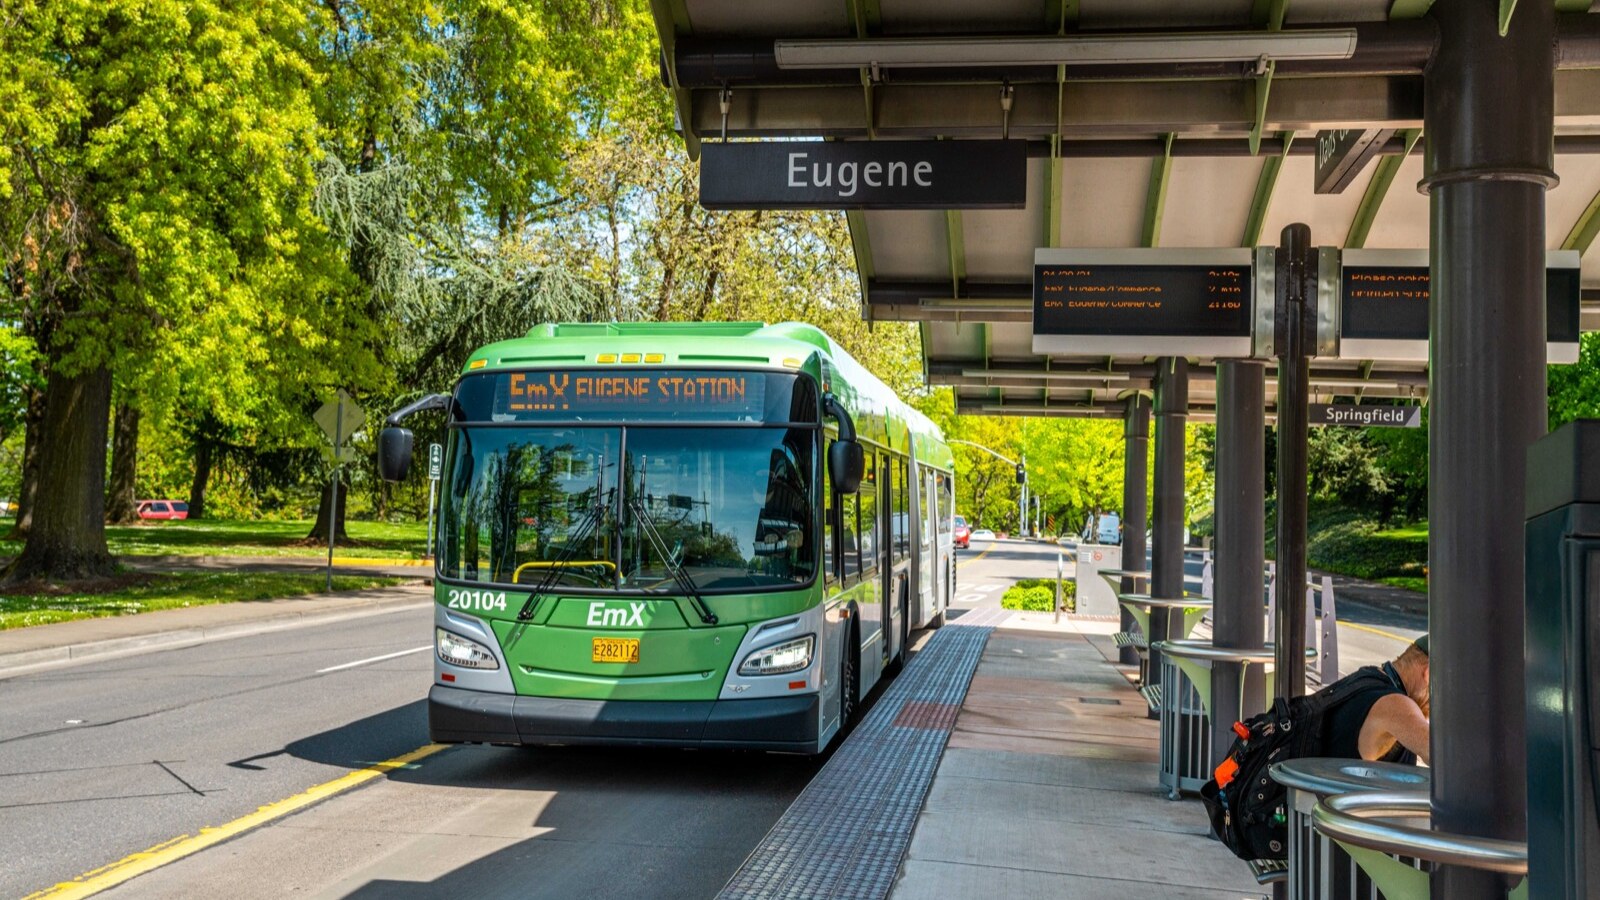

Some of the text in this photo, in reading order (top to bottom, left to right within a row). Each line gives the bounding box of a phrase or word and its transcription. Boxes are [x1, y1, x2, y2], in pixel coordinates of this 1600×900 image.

[788, 152, 933, 197] Eugene
[510, 373, 745, 410] EmX EUGENE STATION
[1326, 407, 1404, 424] Springfield
[448, 589, 507, 611] 20104
[586, 602, 646, 627] EmX
[594, 643, 638, 658] E282112
